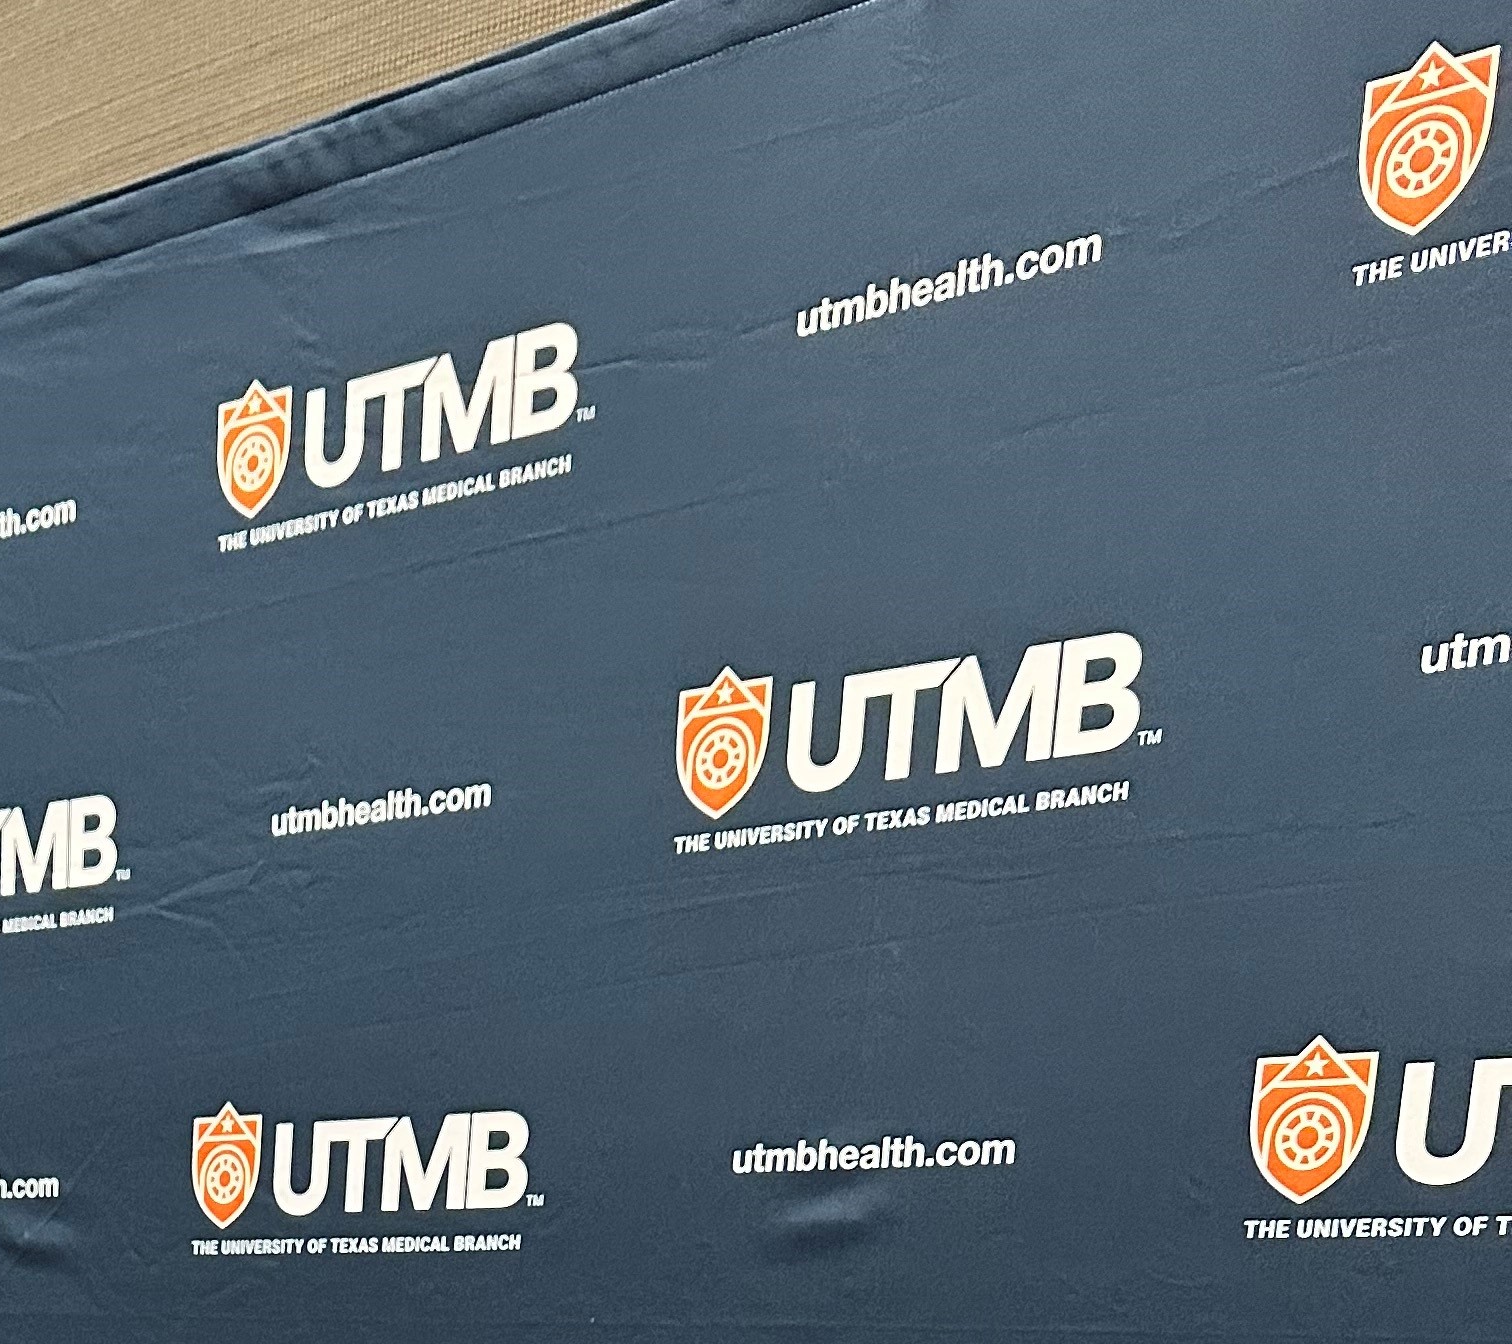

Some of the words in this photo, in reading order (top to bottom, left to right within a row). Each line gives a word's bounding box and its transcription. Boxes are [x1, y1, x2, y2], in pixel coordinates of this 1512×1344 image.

[796, 233, 1103, 338] utmbhealth.com
[1351, 255, 1405, 287] THE
[1409, 230, 1512, 275] UNIVER
[303, 321, 579, 489] UTMB
[217, 529, 248, 553] THE
[341, 503, 365, 526] OF
[366, 490, 419, 520] TEXAS
[421, 472, 496, 507] MEDICAL
[498, 453, 572, 489] BRANCH
[785, 631, 1144, 794] UTMB
[271, 783, 492, 837] utmbhealth.com
[673, 832, 712, 855] THE
[713, 817, 829, 850] UNIVERSITY
[832, 814, 861, 836] OF
[863, 805, 931, 832] TEXAS
[934, 793, 1030, 824] MEDICAL
[1035, 780, 1130, 812] BRANCH
[272, 1109, 530, 1217] UTMB
[732, 1135, 1016, 1174] utmbhealth.com
[190, 1239, 219, 1256] THE
[220, 1238, 305, 1256] UNIVERSITY
[306, 1237, 328, 1254] OF
[329, 1236, 379, 1254] TEXAS
[381, 1235, 451, 1253] MEDICAL
[453, 1233, 522, 1252] BRANCH
[1243, 1219, 1292, 1239] THE
[1296, 1216, 1448, 1239] UNIVERSITY
[1452, 1215, 1490, 1237] OF
